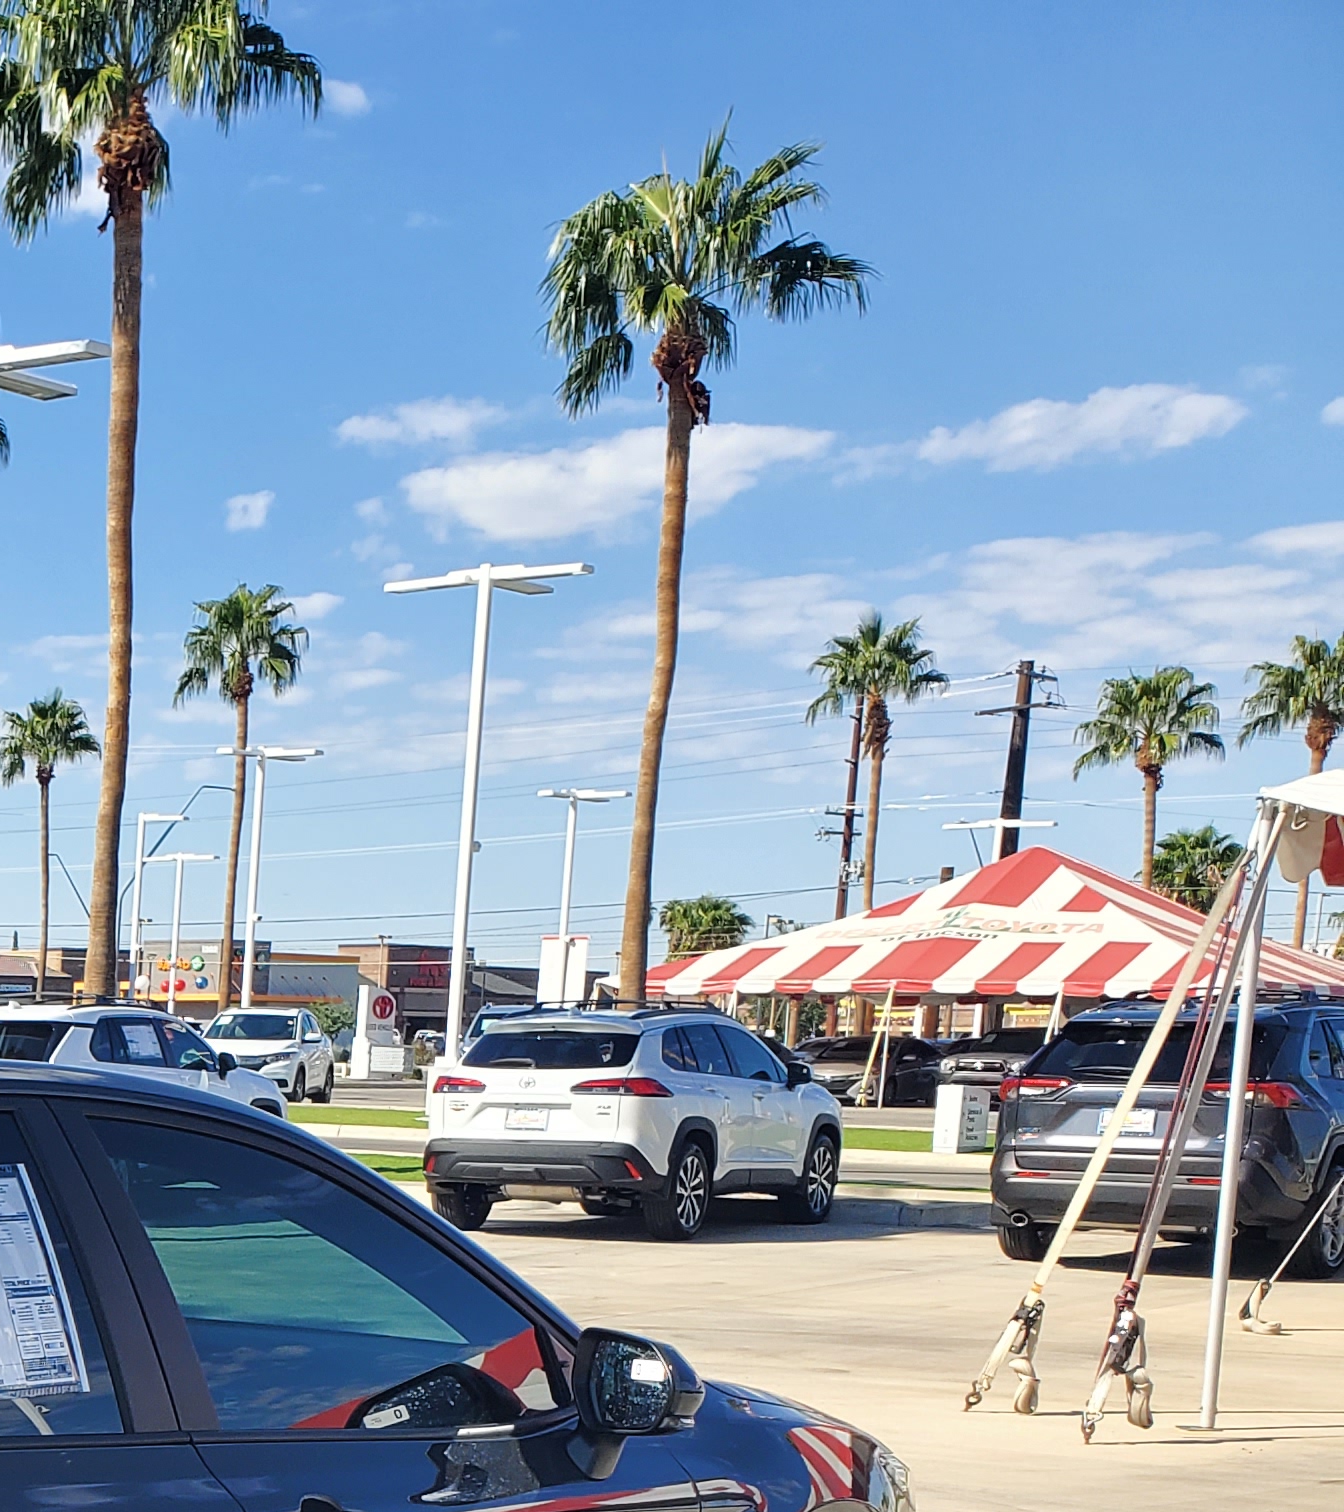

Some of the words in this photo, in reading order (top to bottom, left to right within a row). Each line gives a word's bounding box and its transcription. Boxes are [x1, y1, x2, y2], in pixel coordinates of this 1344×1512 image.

[816, 920, 947, 940] DESERT
[962, 917, 1105, 934] TOYOTA
[916, 930, 998, 940] Tucson
